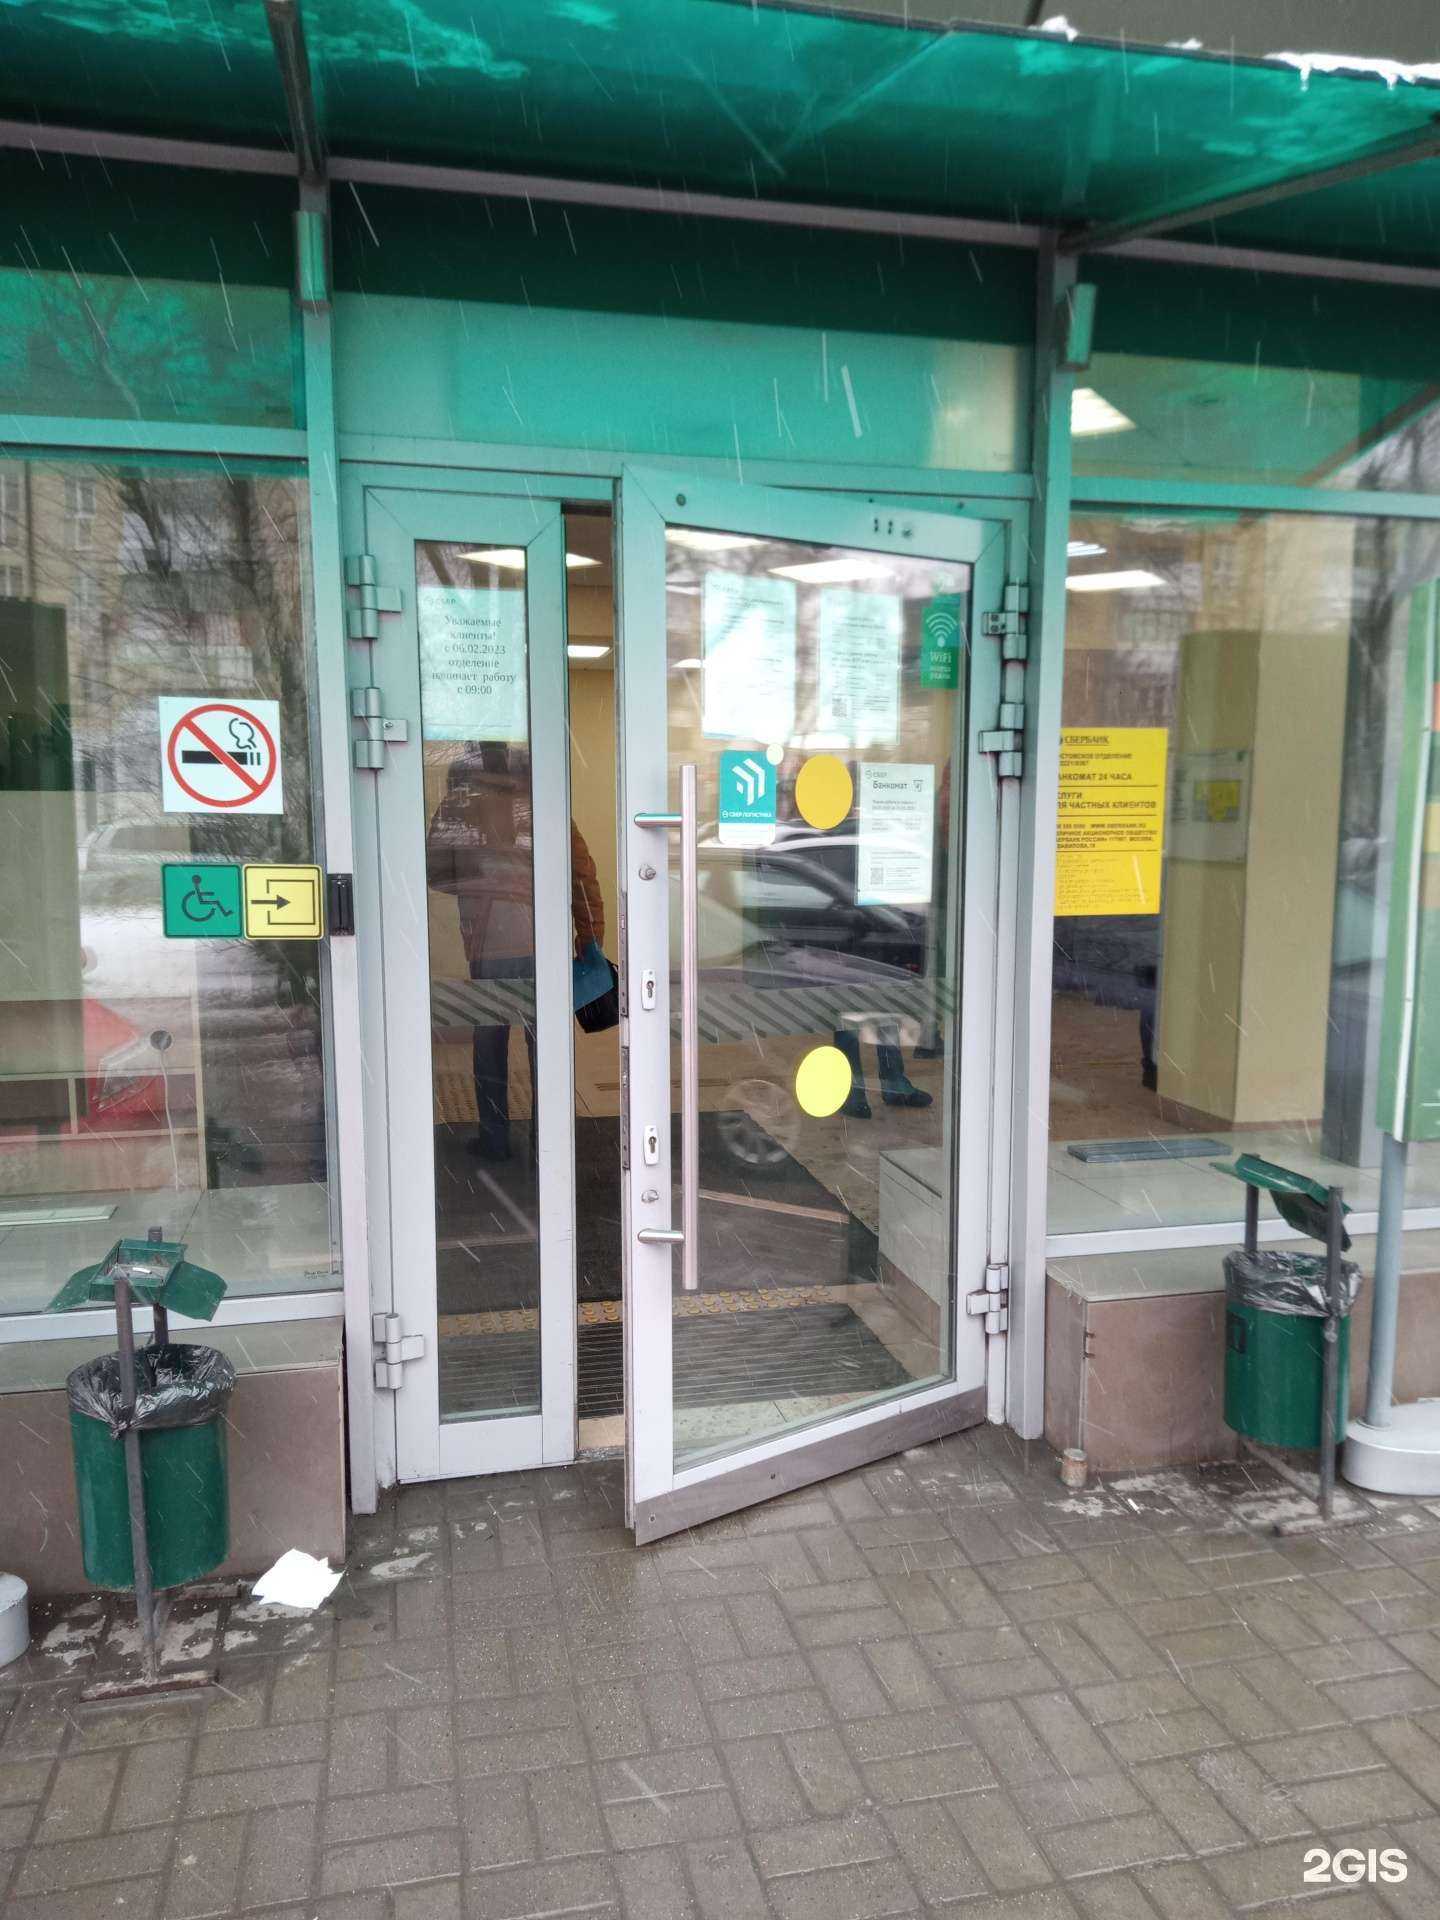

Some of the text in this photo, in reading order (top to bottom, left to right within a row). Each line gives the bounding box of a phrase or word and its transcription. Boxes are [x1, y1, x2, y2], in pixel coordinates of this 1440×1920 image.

[445, 616, 502, 628] Уважаемые
[482, 672, 516, 684] работу
[465, 685, 492, 694] 09:00
[1112, 801, 1157, 809] КЛИЕНТОВ
